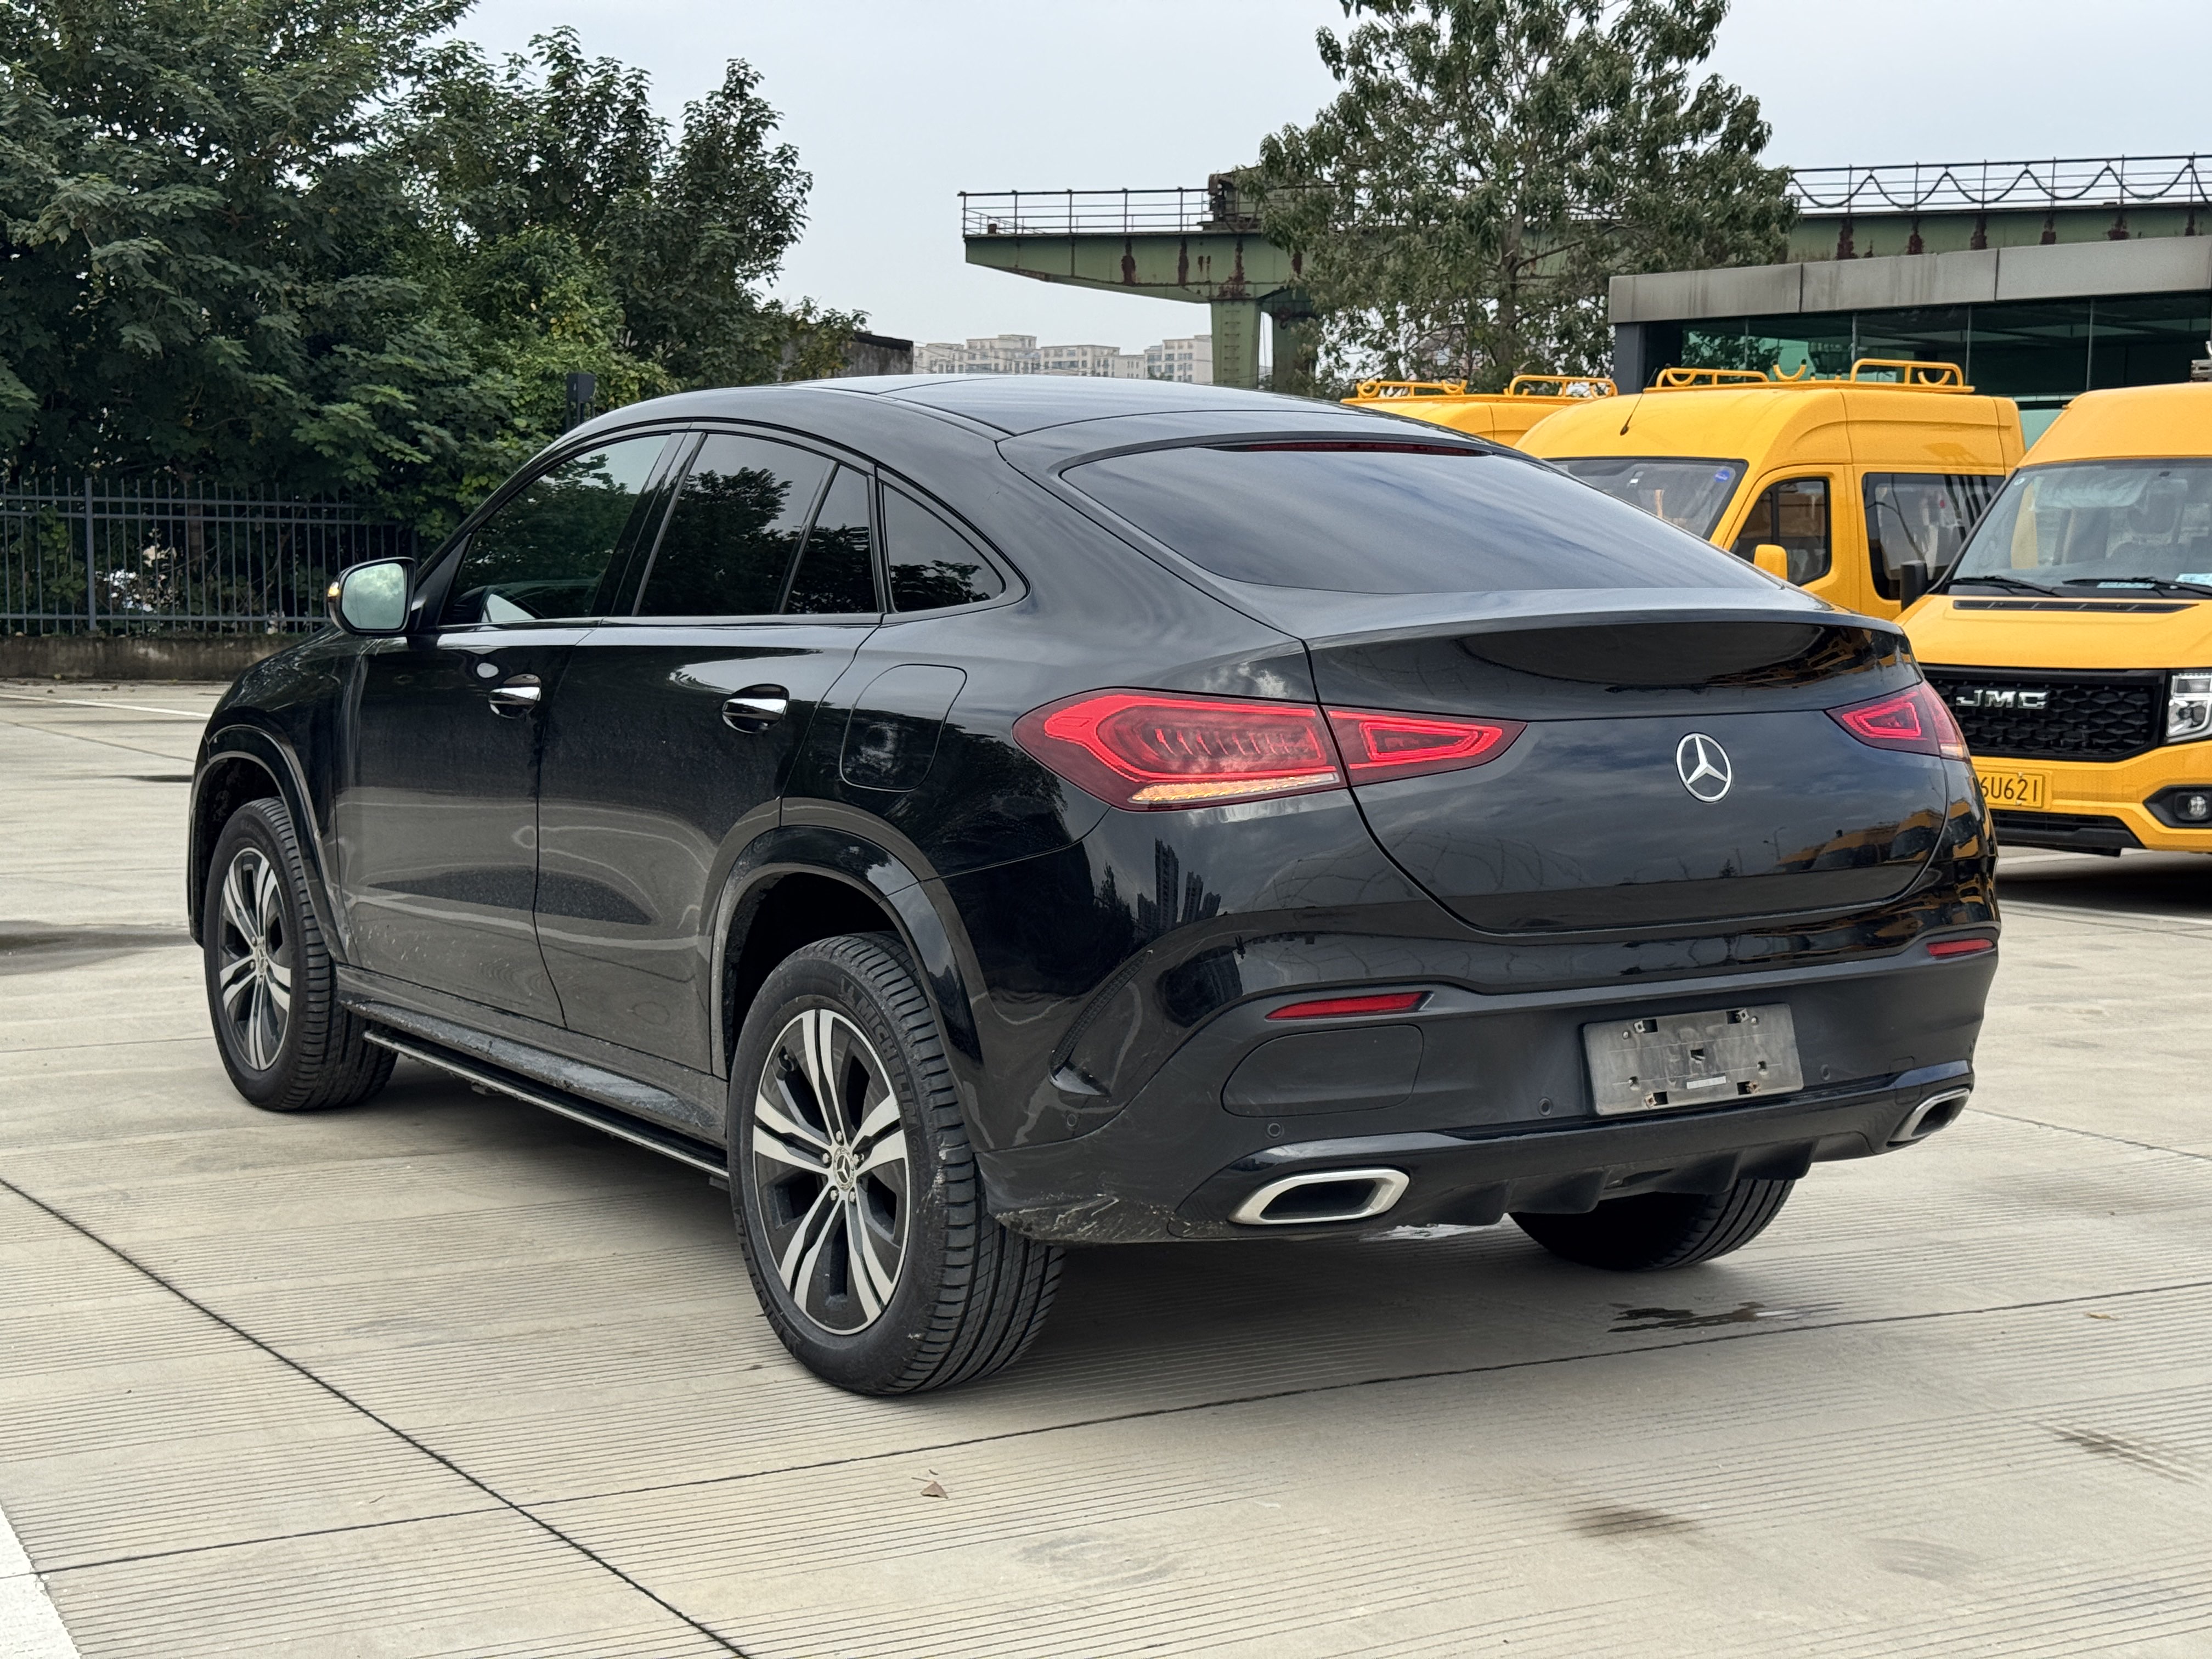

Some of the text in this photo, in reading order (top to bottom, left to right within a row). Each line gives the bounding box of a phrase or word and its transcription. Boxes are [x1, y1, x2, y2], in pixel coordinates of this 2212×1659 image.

[1955, 689, 2049, 709] JMC
[1980, 777, 2037, 802] 6U621
[856, 997, 918, 1125] MICHELIN
